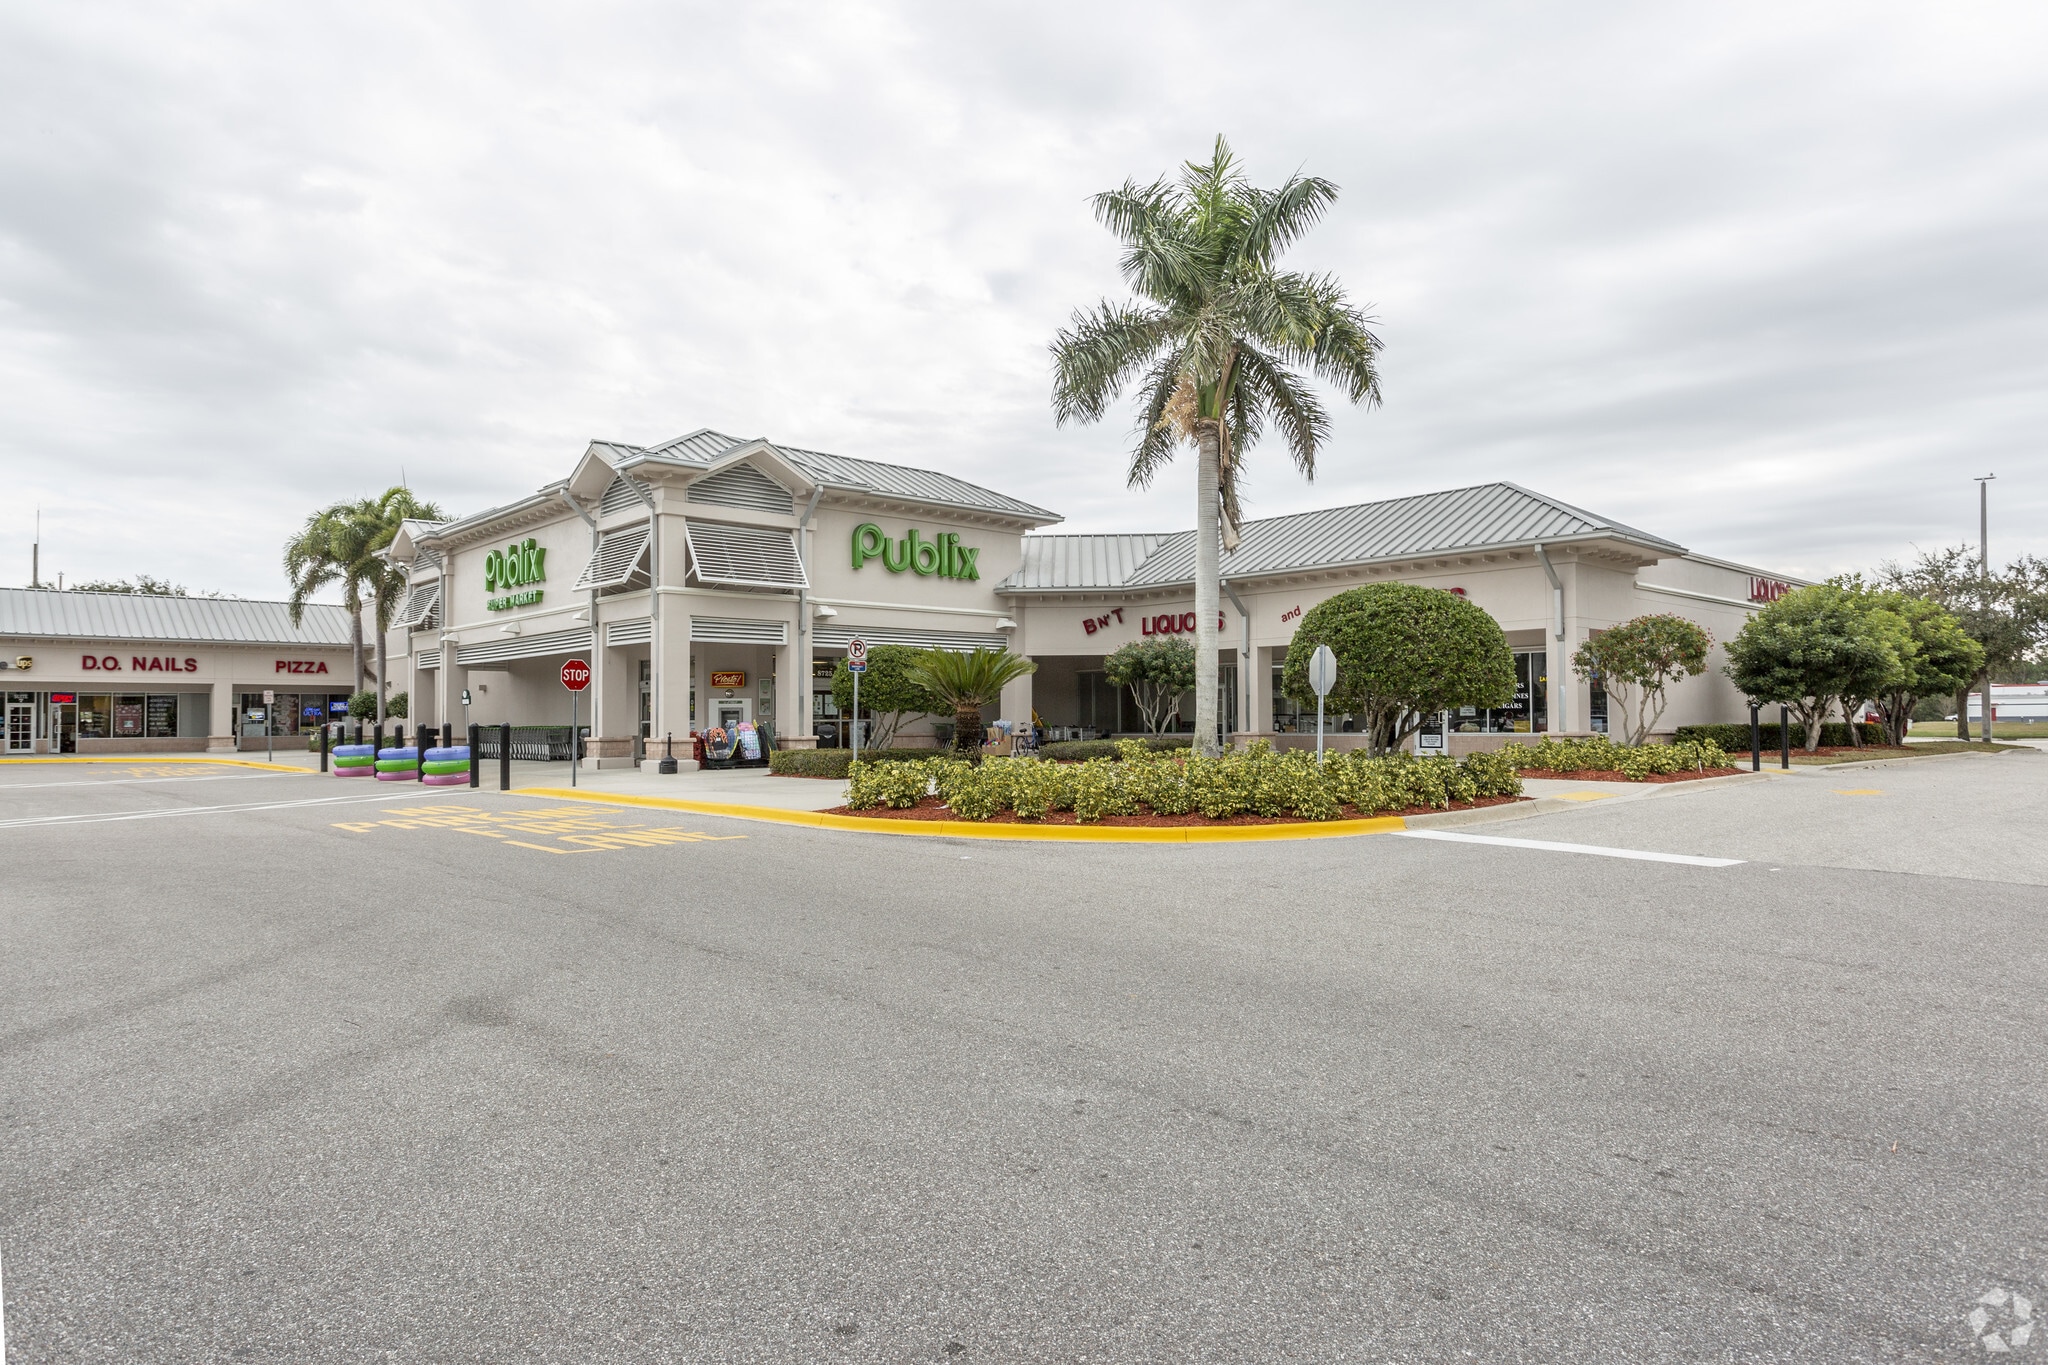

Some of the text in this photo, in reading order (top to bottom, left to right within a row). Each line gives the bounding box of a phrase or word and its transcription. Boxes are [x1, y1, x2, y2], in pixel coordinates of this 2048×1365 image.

[850, 523, 980, 580] Publix
[485, 538, 547, 593] Publix
[487, 590, 544, 612] SUPER MARKET
[1142, 611, 1224, 635] LIQUO
[1281, 606, 1302, 623] and
[82, 655, 198, 672] D.O. NAILS
[275, 660, 328, 674] PIZZA
[817, 669, 833, 677] 8725
[563, 669, 589, 681] STOP
